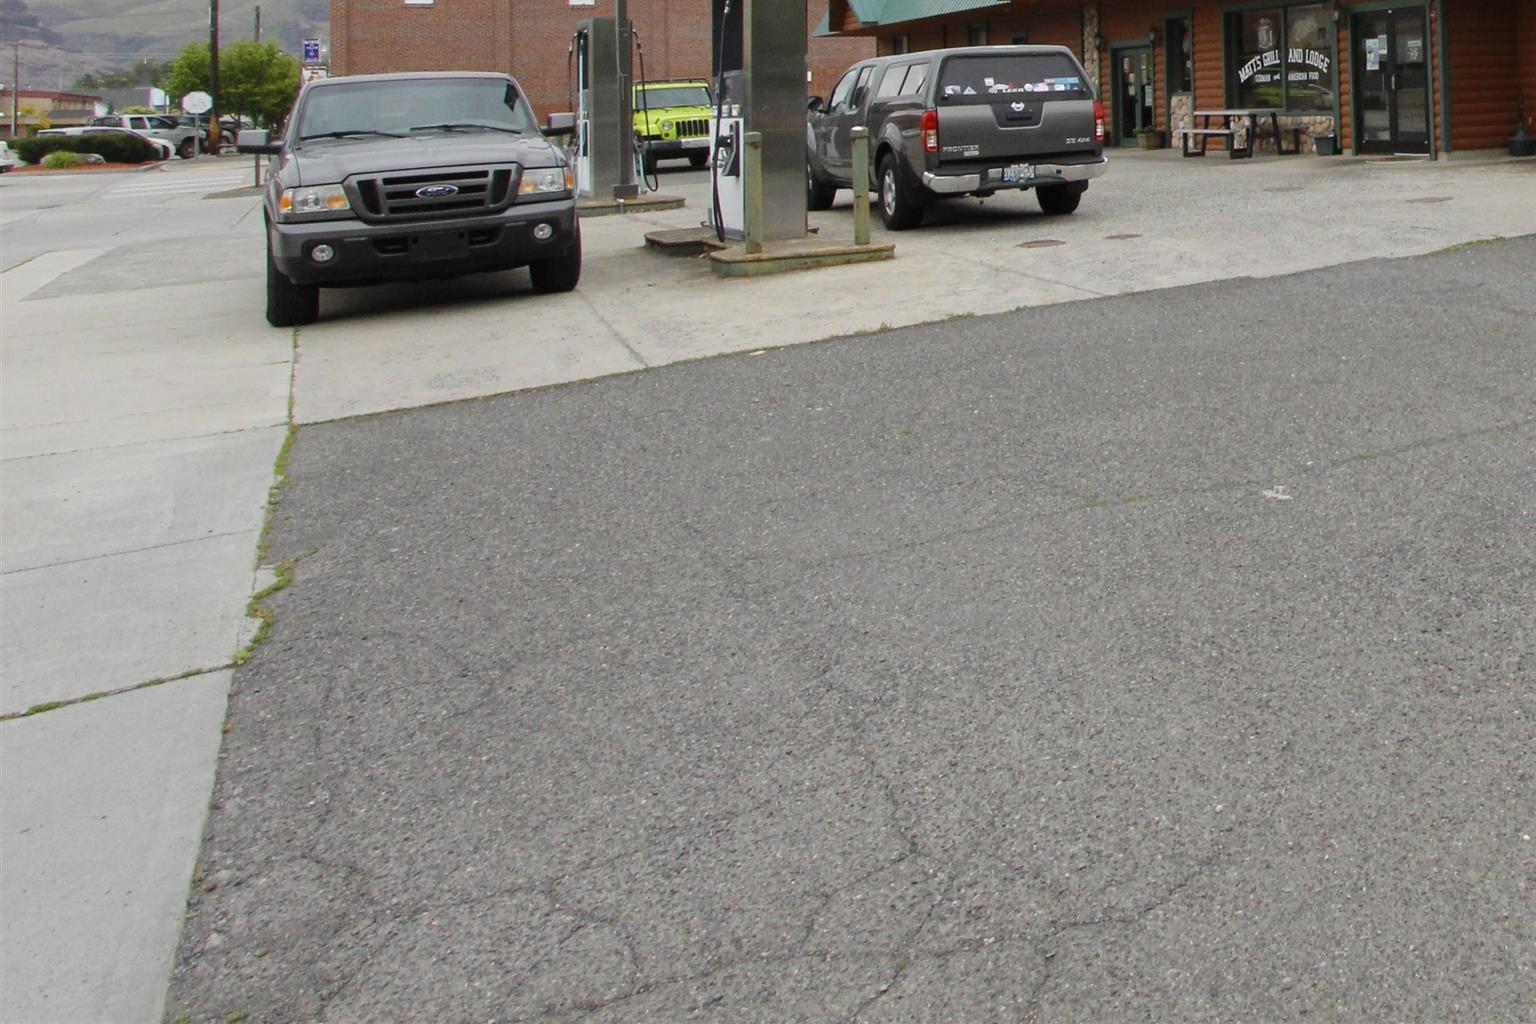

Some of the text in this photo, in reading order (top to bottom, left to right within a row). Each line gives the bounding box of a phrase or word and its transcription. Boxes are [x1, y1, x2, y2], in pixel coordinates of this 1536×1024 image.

[1262, 49, 1280, 67] GRILL
[1288, 48, 1304, 63] AND
[1305, 49, 1330, 73] LODGE
[1288, 72, 1307, 81] AMERICAN
[1308, 71, 1320, 80] FOOD
[942, 145, 979, 153] FRONTIER
